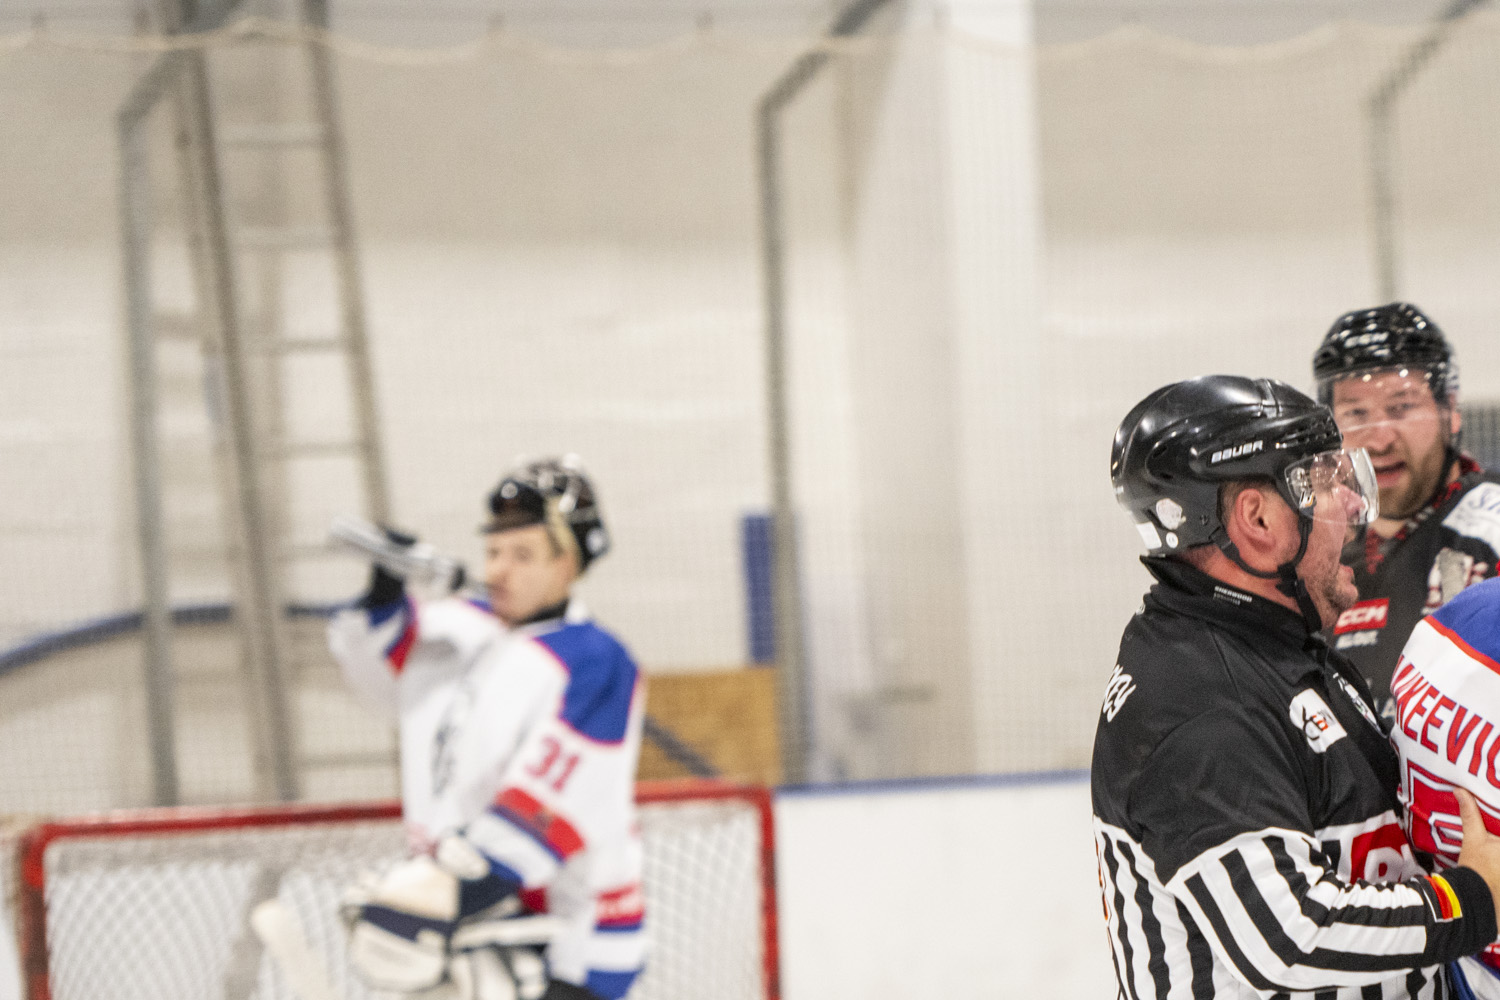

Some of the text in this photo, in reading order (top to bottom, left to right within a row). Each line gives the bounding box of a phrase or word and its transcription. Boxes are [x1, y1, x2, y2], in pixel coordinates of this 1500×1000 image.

[1211, 440, 1264, 464] BAUER
[1336, 604, 1388, 628] CCM
[524, 735, 581, 794] 31
